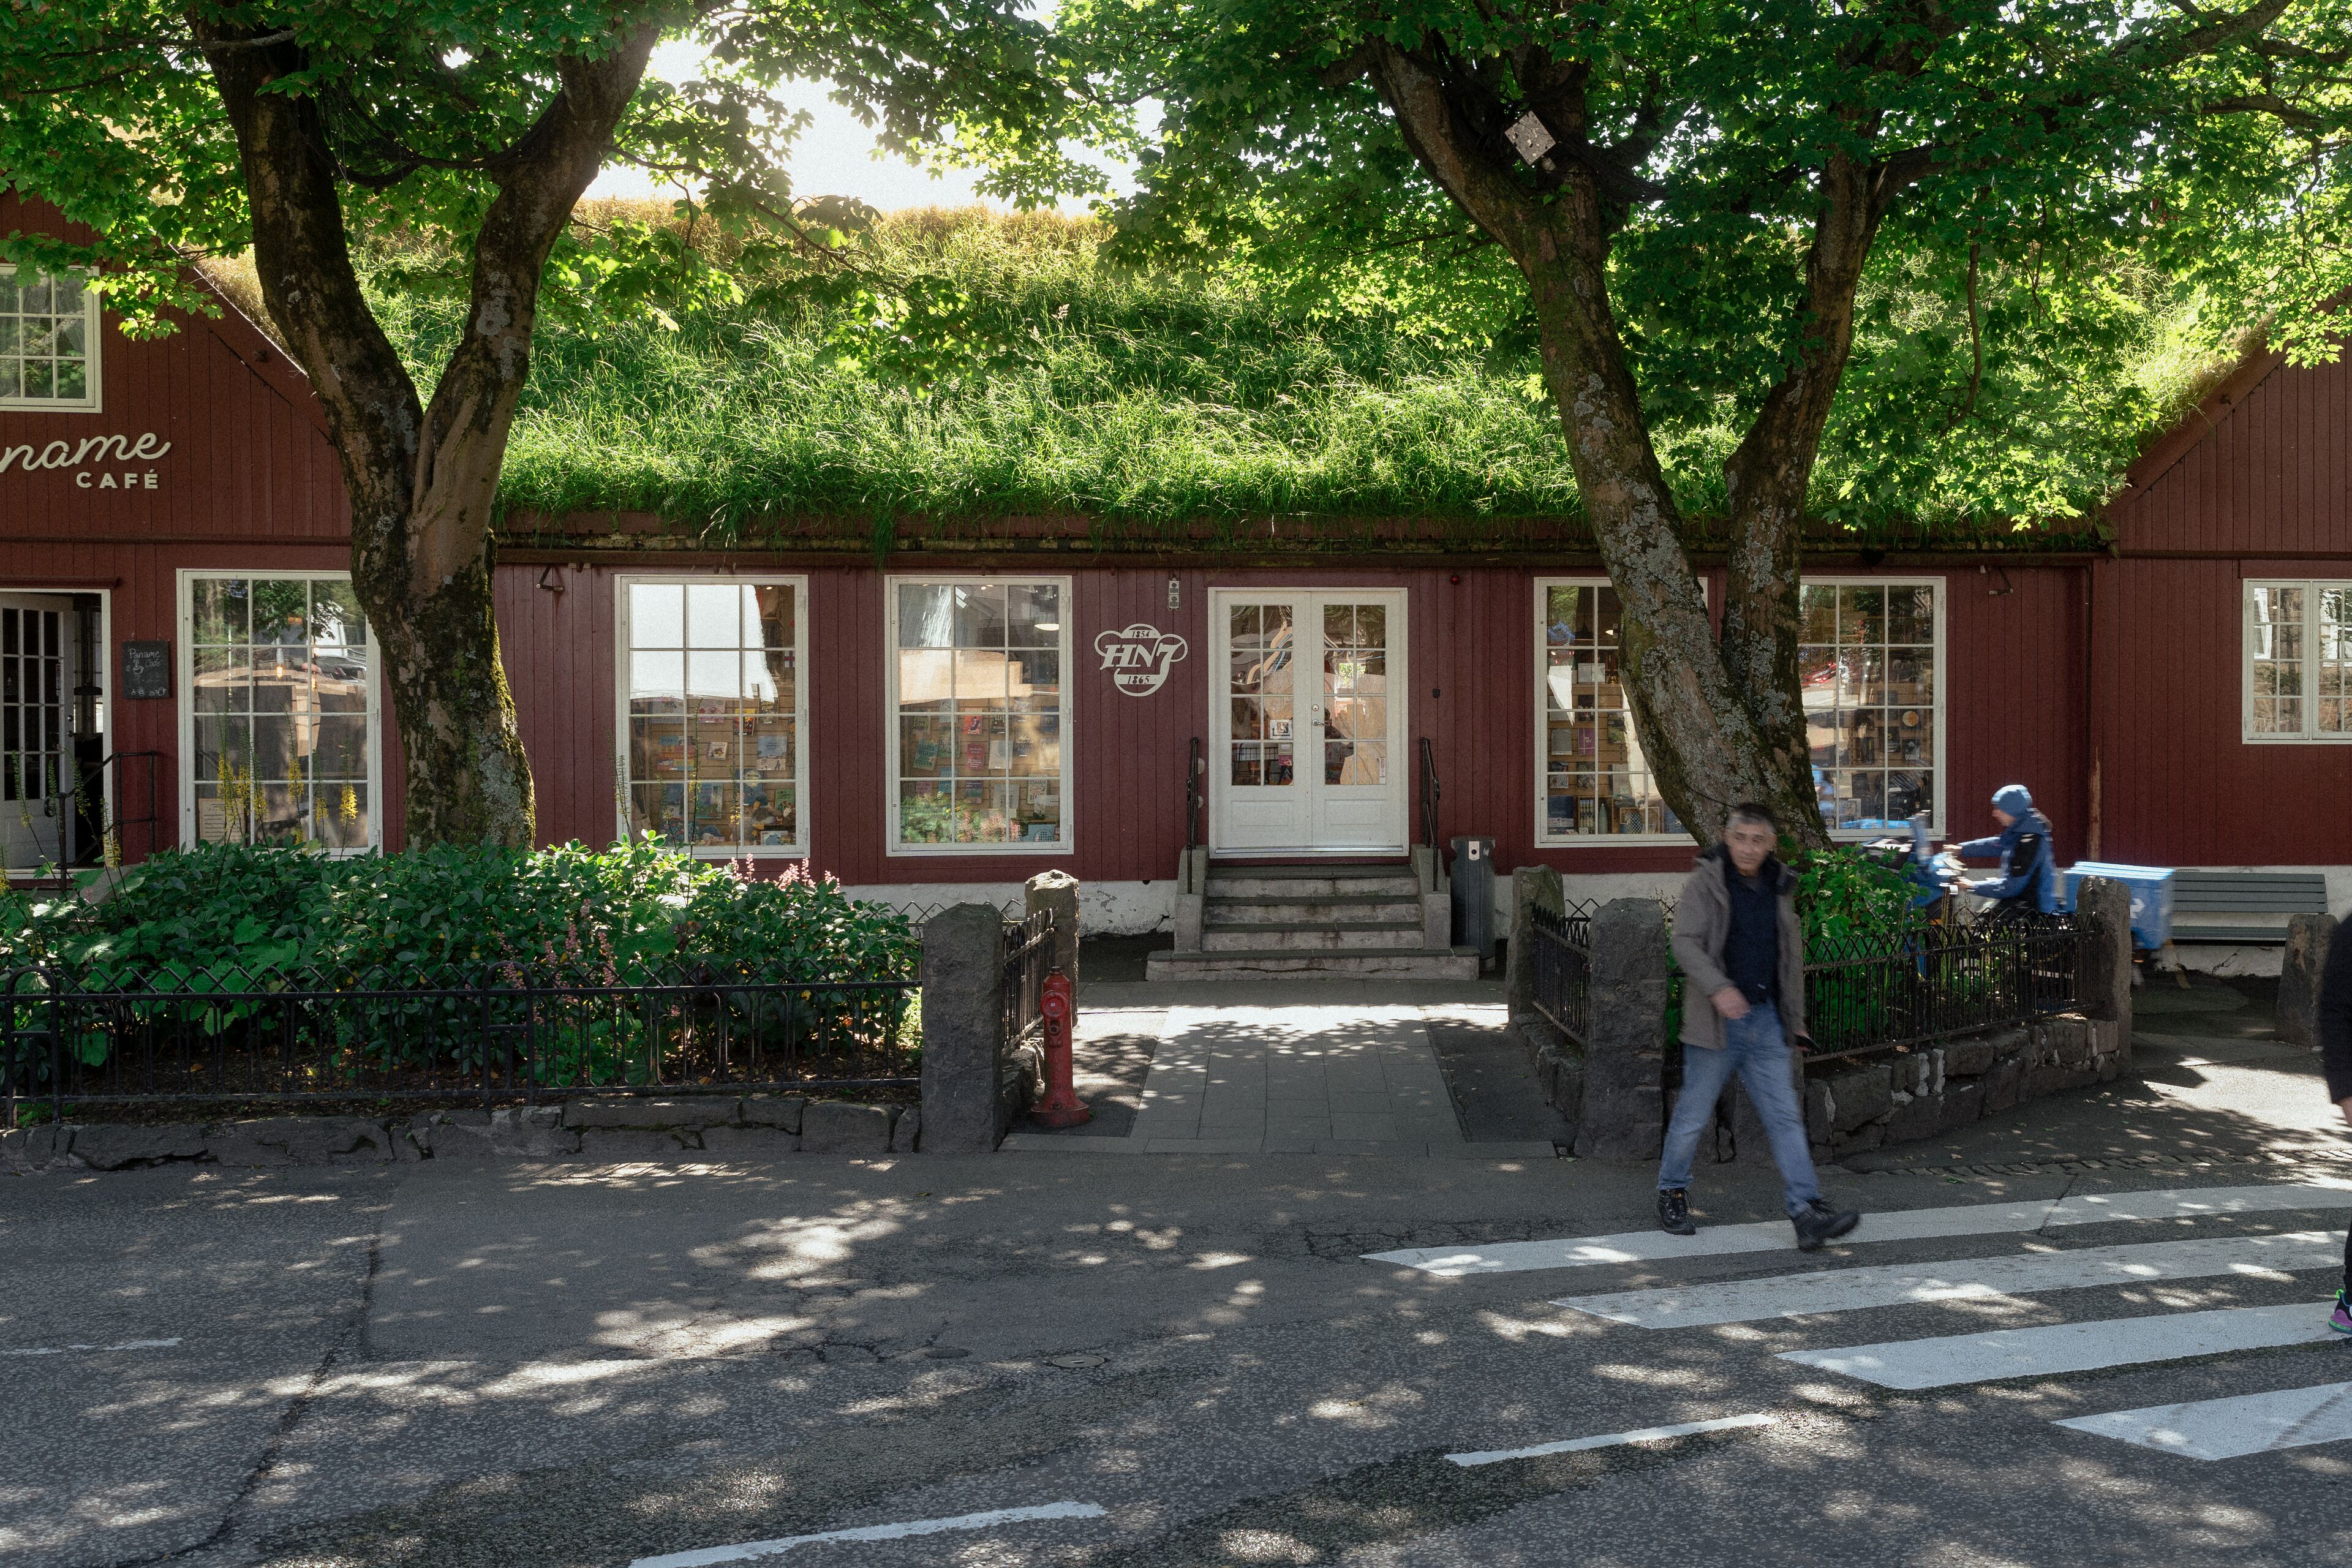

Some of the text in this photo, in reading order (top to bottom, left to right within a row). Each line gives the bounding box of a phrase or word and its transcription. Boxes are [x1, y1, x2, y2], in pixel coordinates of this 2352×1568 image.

[77, 469, 159, 489] CAFÉ
[128, 648, 160, 658] Paname
[1098, 641, 1186, 674] HN7
[1127, 676, 1150, 684] 1865
